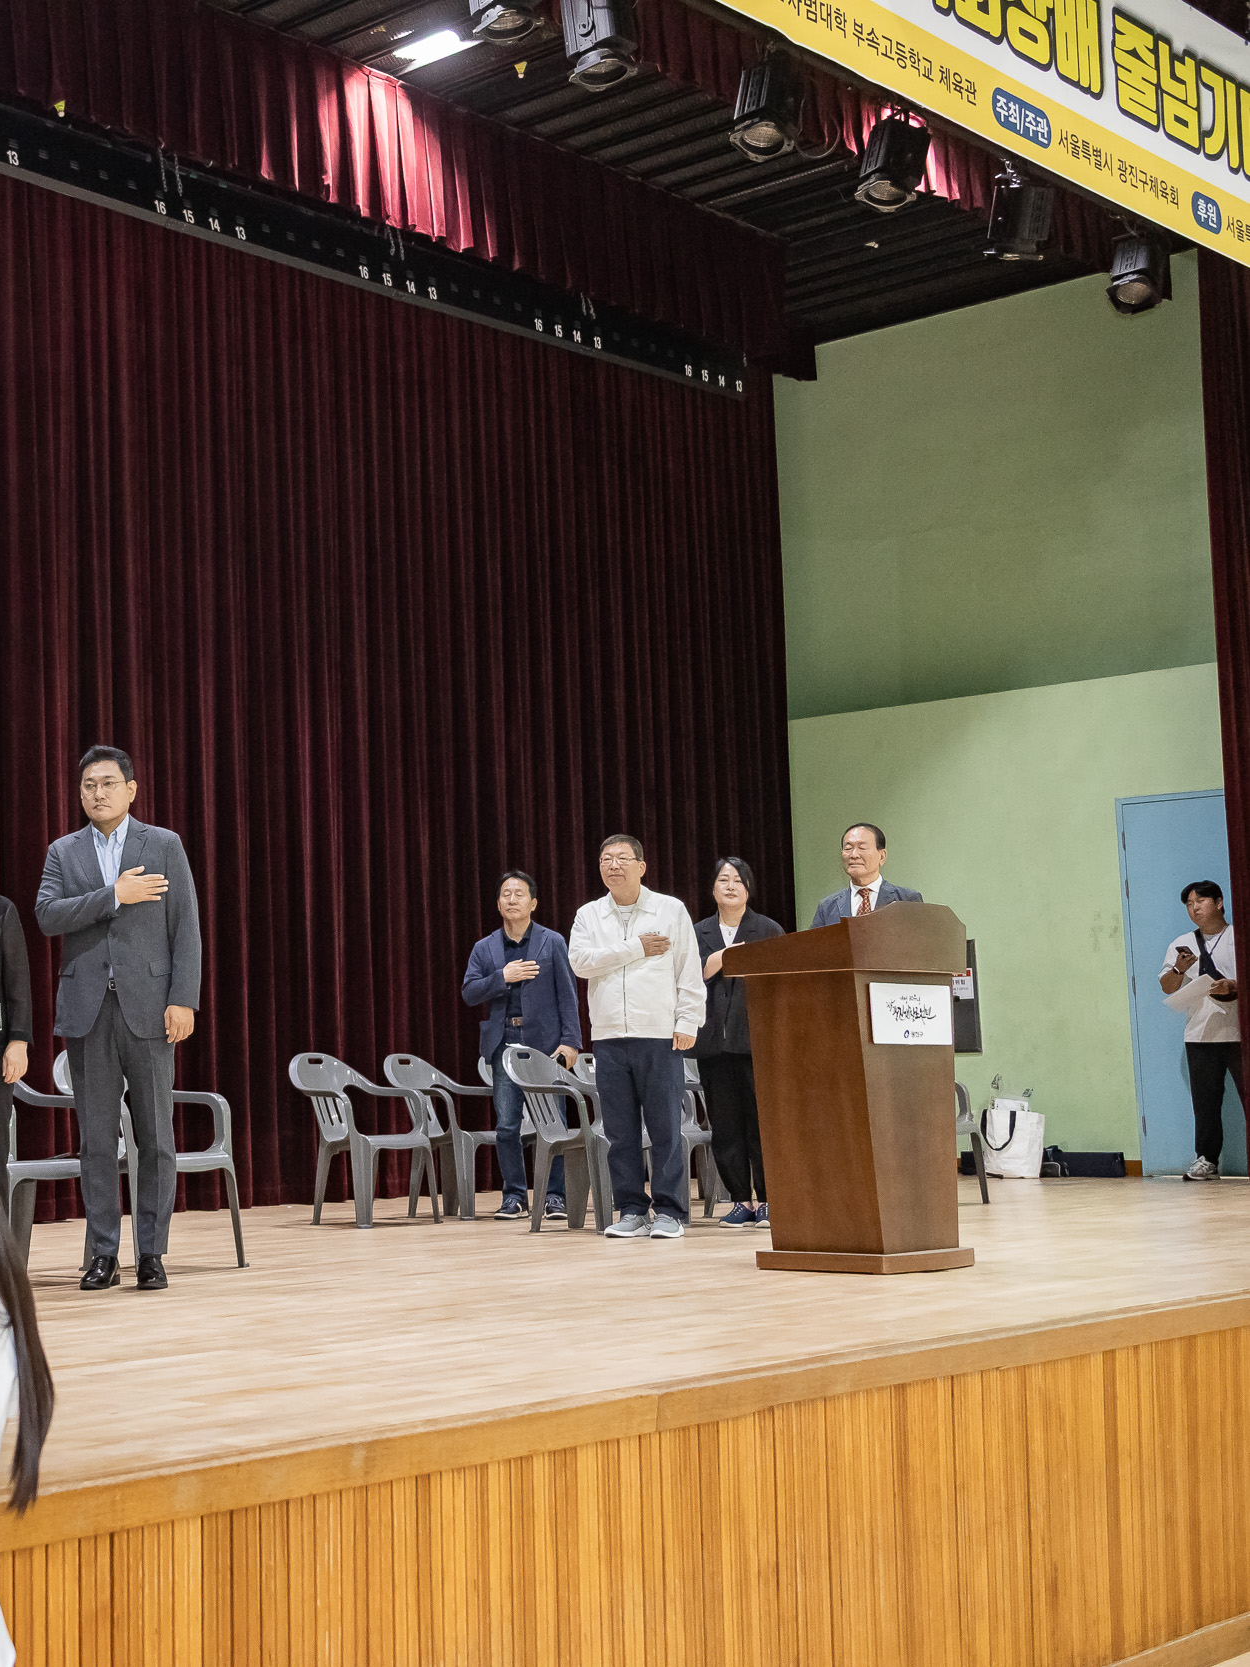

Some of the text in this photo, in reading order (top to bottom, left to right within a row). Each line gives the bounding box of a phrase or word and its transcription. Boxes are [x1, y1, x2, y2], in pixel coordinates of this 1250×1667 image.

[852, 18, 934, 83] 부속고등학교
[939, 64, 977, 107] 체육관
[1113, 11, 1250, 179] 줄넘기
[6, 150, 20, 166] 13
[995, 94, 1180, 210] 주최/주관 서울특별시 광진구체육회
[154, 199, 247, 241] 16 15 14 13
[1197, 198, 1218, 229] 후원
[358, 265, 438, 300] 16 15 14 13
[534, 318, 603, 350] 16 15 14 13
[684, 364, 743, 393] 16 15 14 13
